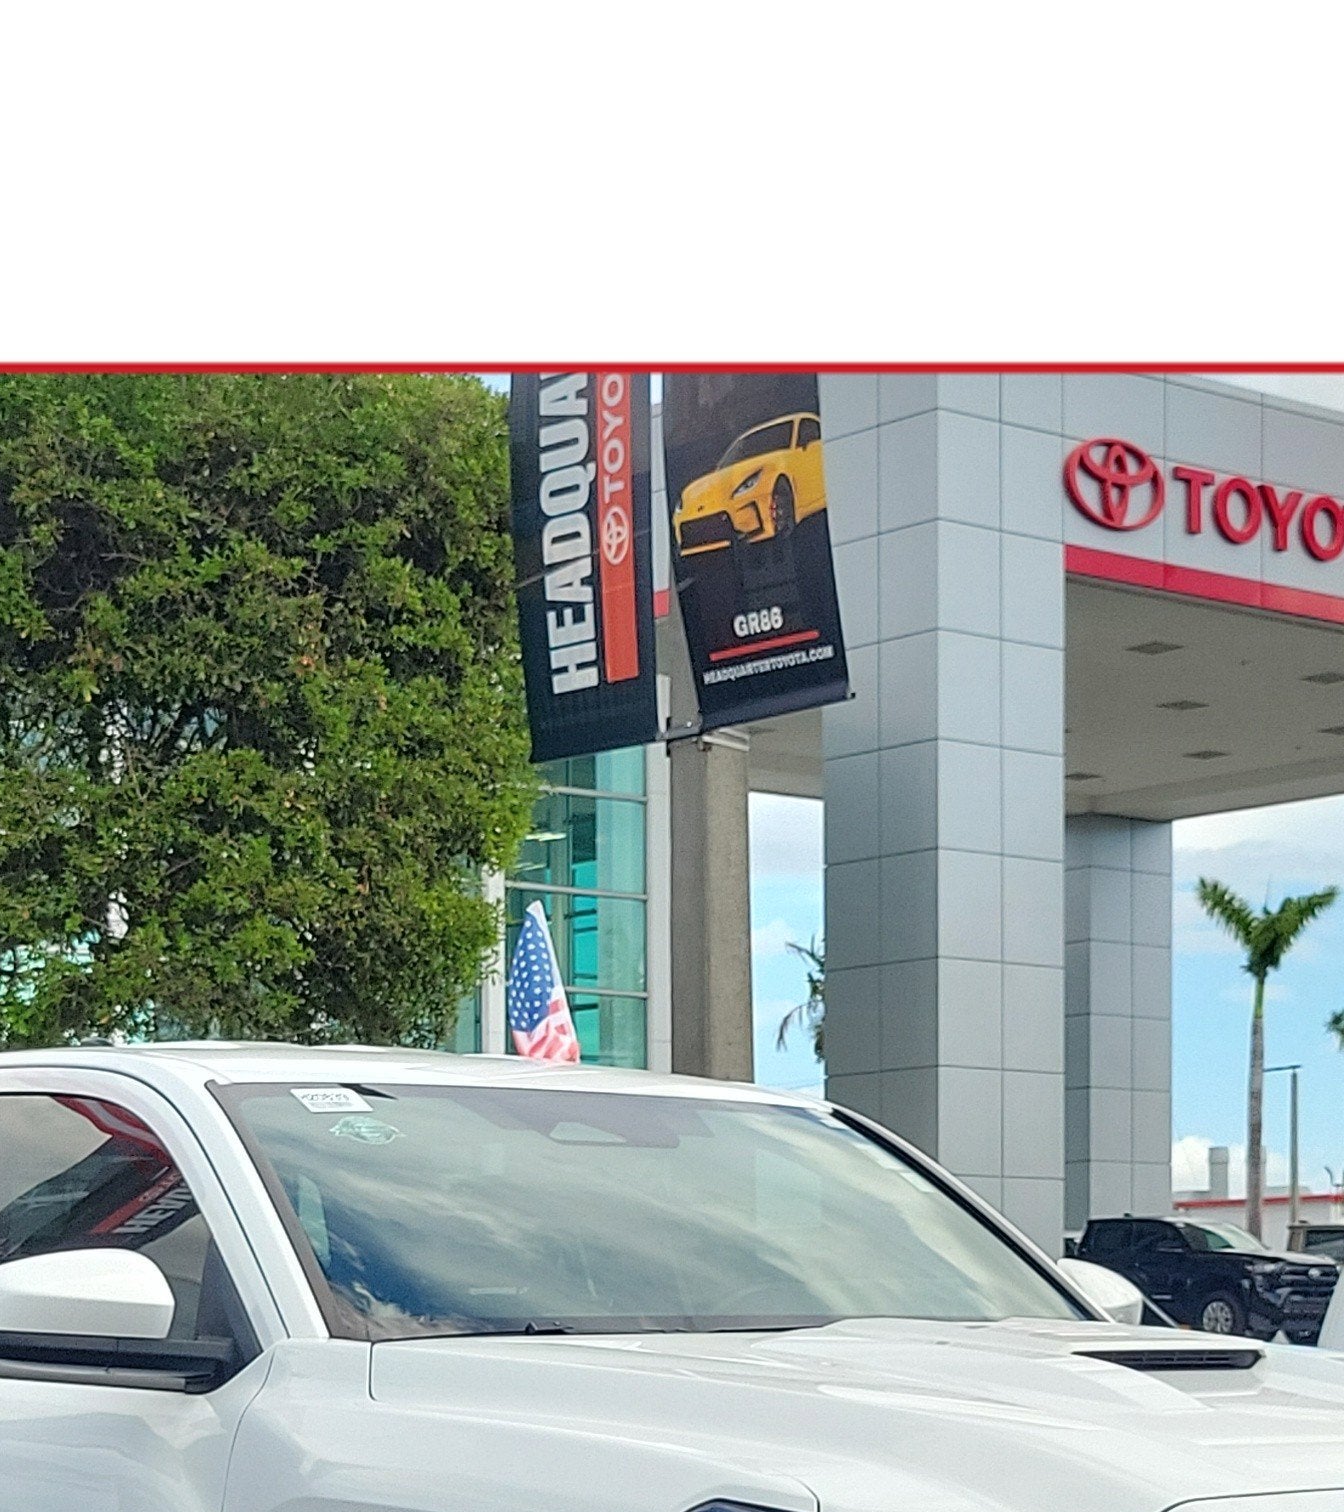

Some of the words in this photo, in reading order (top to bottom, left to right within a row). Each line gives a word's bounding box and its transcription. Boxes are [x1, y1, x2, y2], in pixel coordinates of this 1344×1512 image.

[538, 372, 599, 695] HEADQUA
[732, 605, 785, 638] GR86
[702, 644, 835, 685] HEADQUARTERTOYOTA.COM
